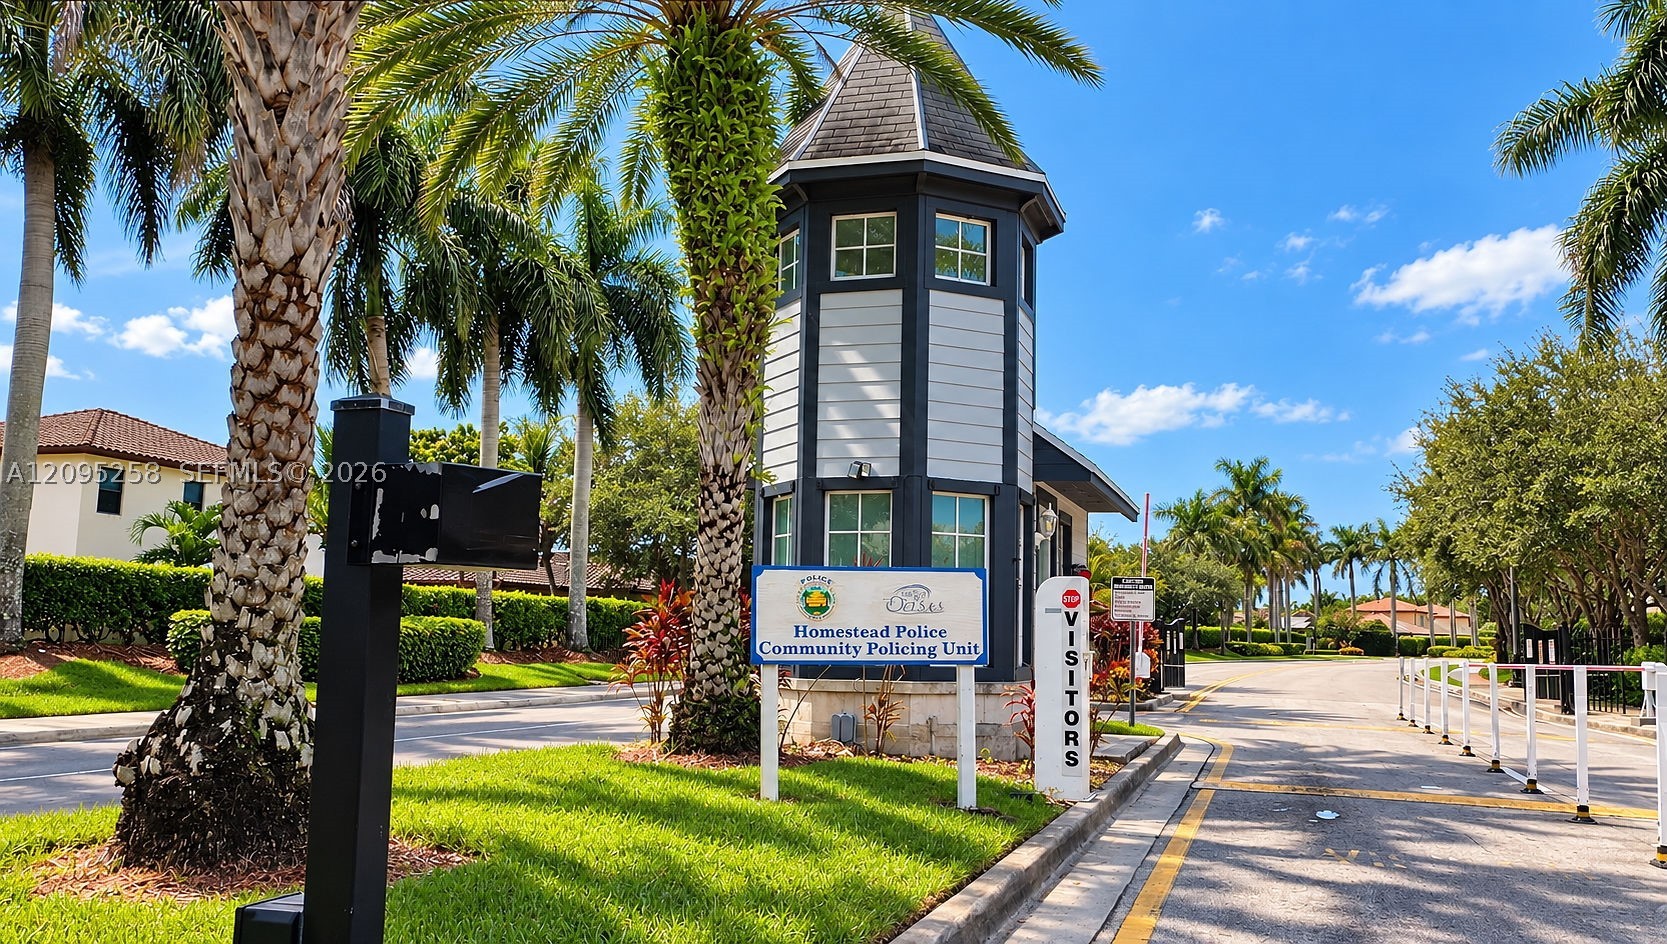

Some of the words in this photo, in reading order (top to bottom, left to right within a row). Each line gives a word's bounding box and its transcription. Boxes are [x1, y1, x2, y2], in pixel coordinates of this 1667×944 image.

[800, 574, 833, 585] POLICE
[1063, 595, 1080, 603] STOP
[793, 625, 890, 638] Homestead
[895, 625, 947, 638] Police
[759, 641, 862, 658] Community
[866, 641, 937, 658] Policing
[942, 642, 980, 655] Unit
[1064, 611, 1079, 767] VISITORS
